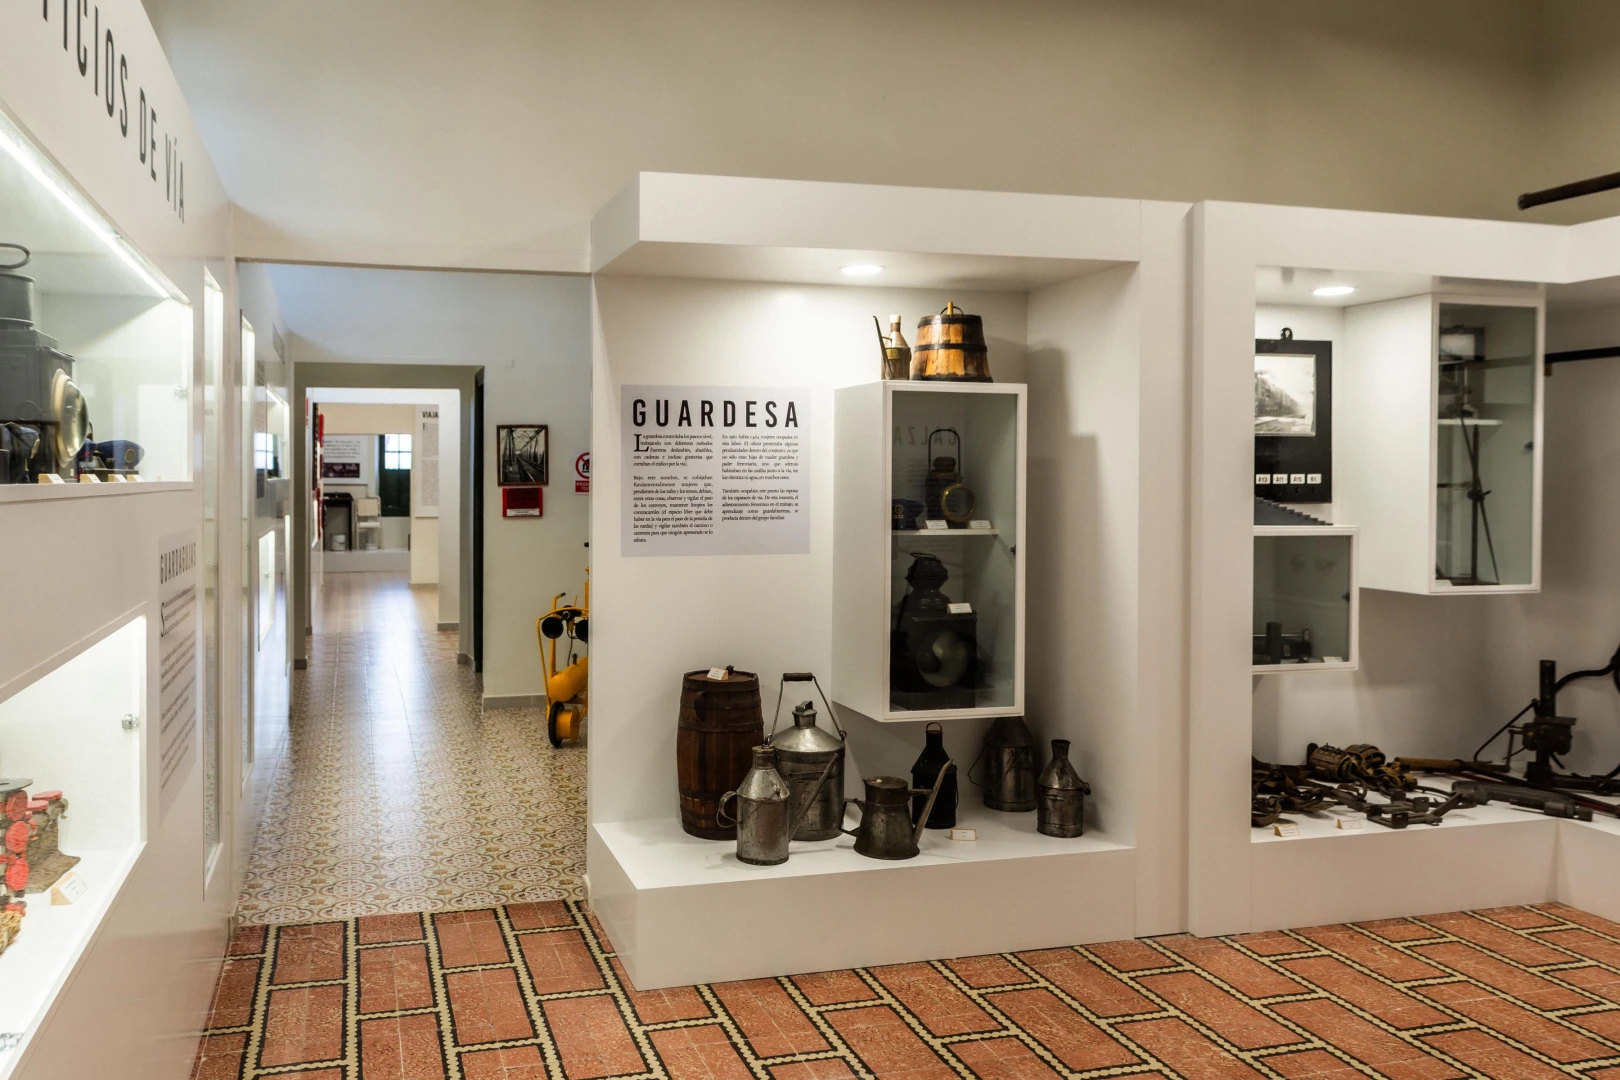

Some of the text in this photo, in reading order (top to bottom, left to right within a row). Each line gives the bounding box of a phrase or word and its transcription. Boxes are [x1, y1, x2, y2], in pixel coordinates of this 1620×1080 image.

[42, 0, 185, 224] ICIOS DE VÍA
[633, 398, 798, 428] GUARDESA
